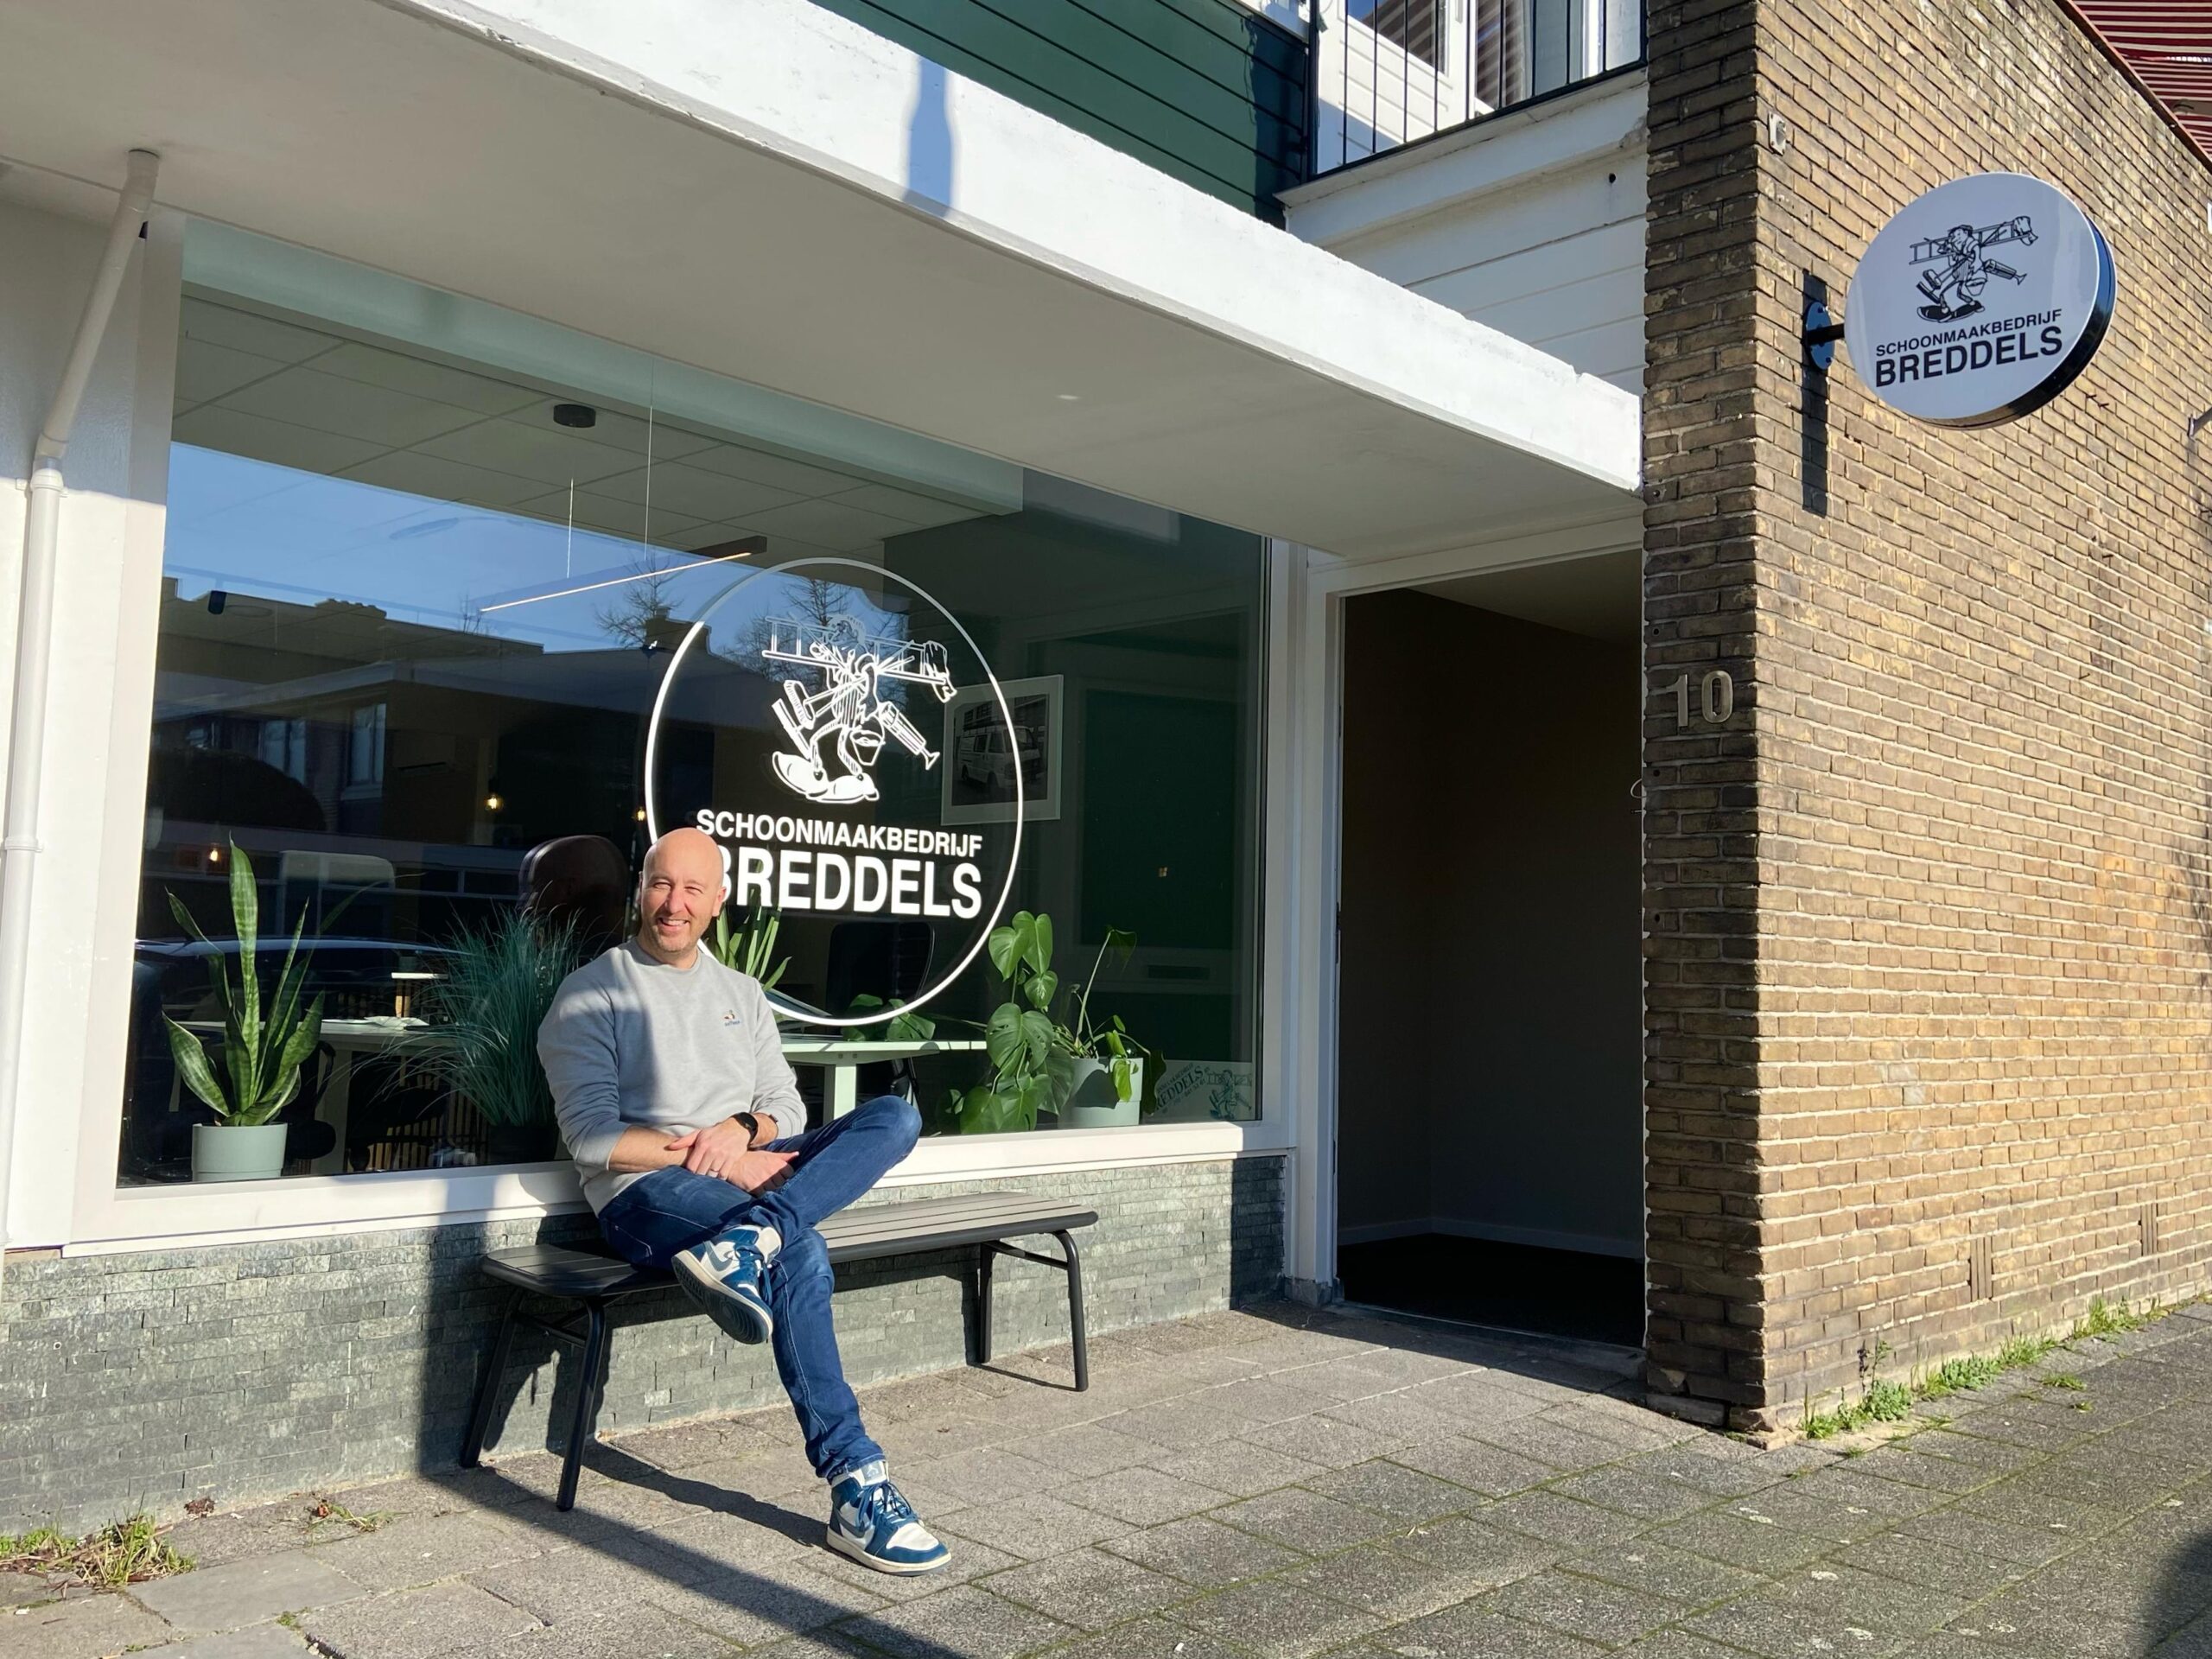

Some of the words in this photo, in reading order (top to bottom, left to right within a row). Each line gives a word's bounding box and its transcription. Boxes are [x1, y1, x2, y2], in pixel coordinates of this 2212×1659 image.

[1876, 308, 2063, 358] SCHOONMAAKBEDRIJF
[1876, 325, 2063, 388] BREDDELS
[1665, 670, 1733, 727] 10
[696, 809, 983, 858] SCHOONMAAKBEDRIJF
